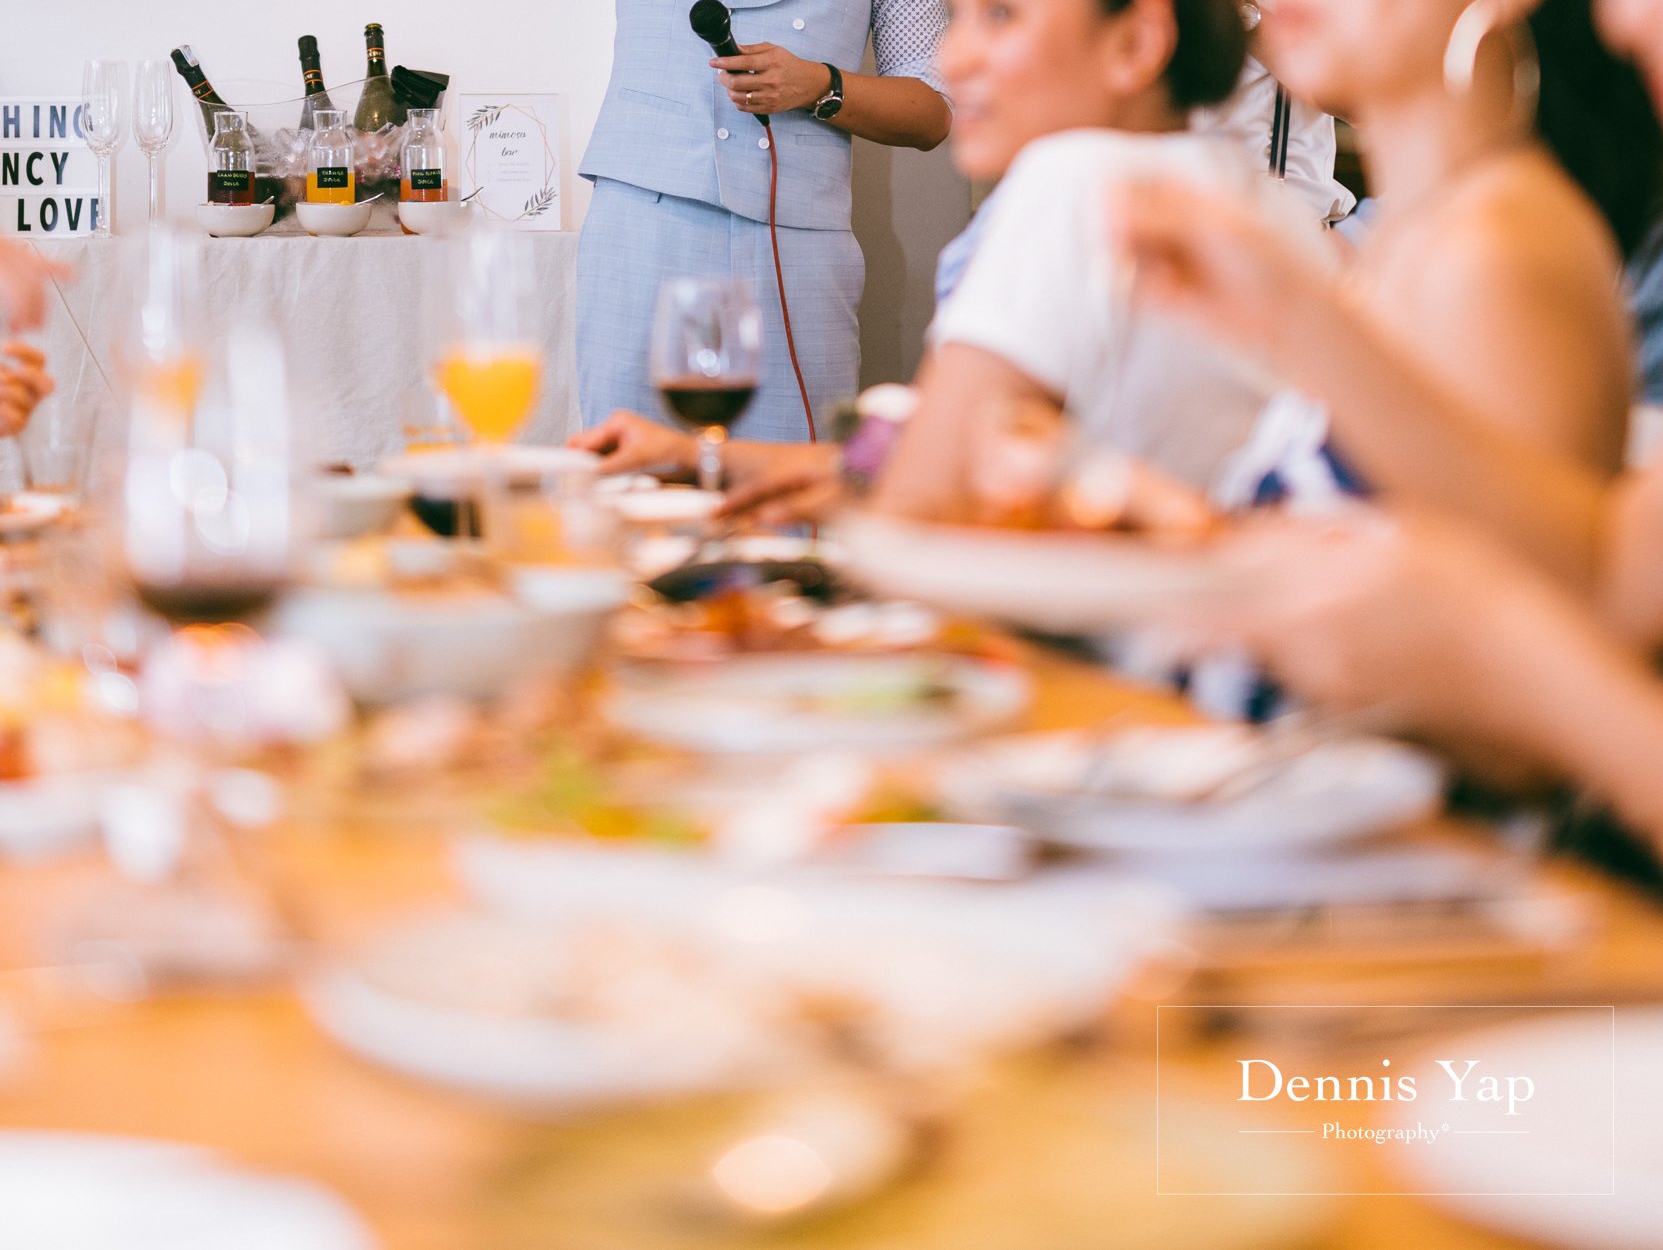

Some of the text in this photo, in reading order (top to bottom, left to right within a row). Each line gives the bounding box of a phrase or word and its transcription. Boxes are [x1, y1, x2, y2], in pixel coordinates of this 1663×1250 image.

[489, 131, 527, 139] mimosa
[501, 146, 518, 157] bar
[2, 151, 69, 186] NCY
